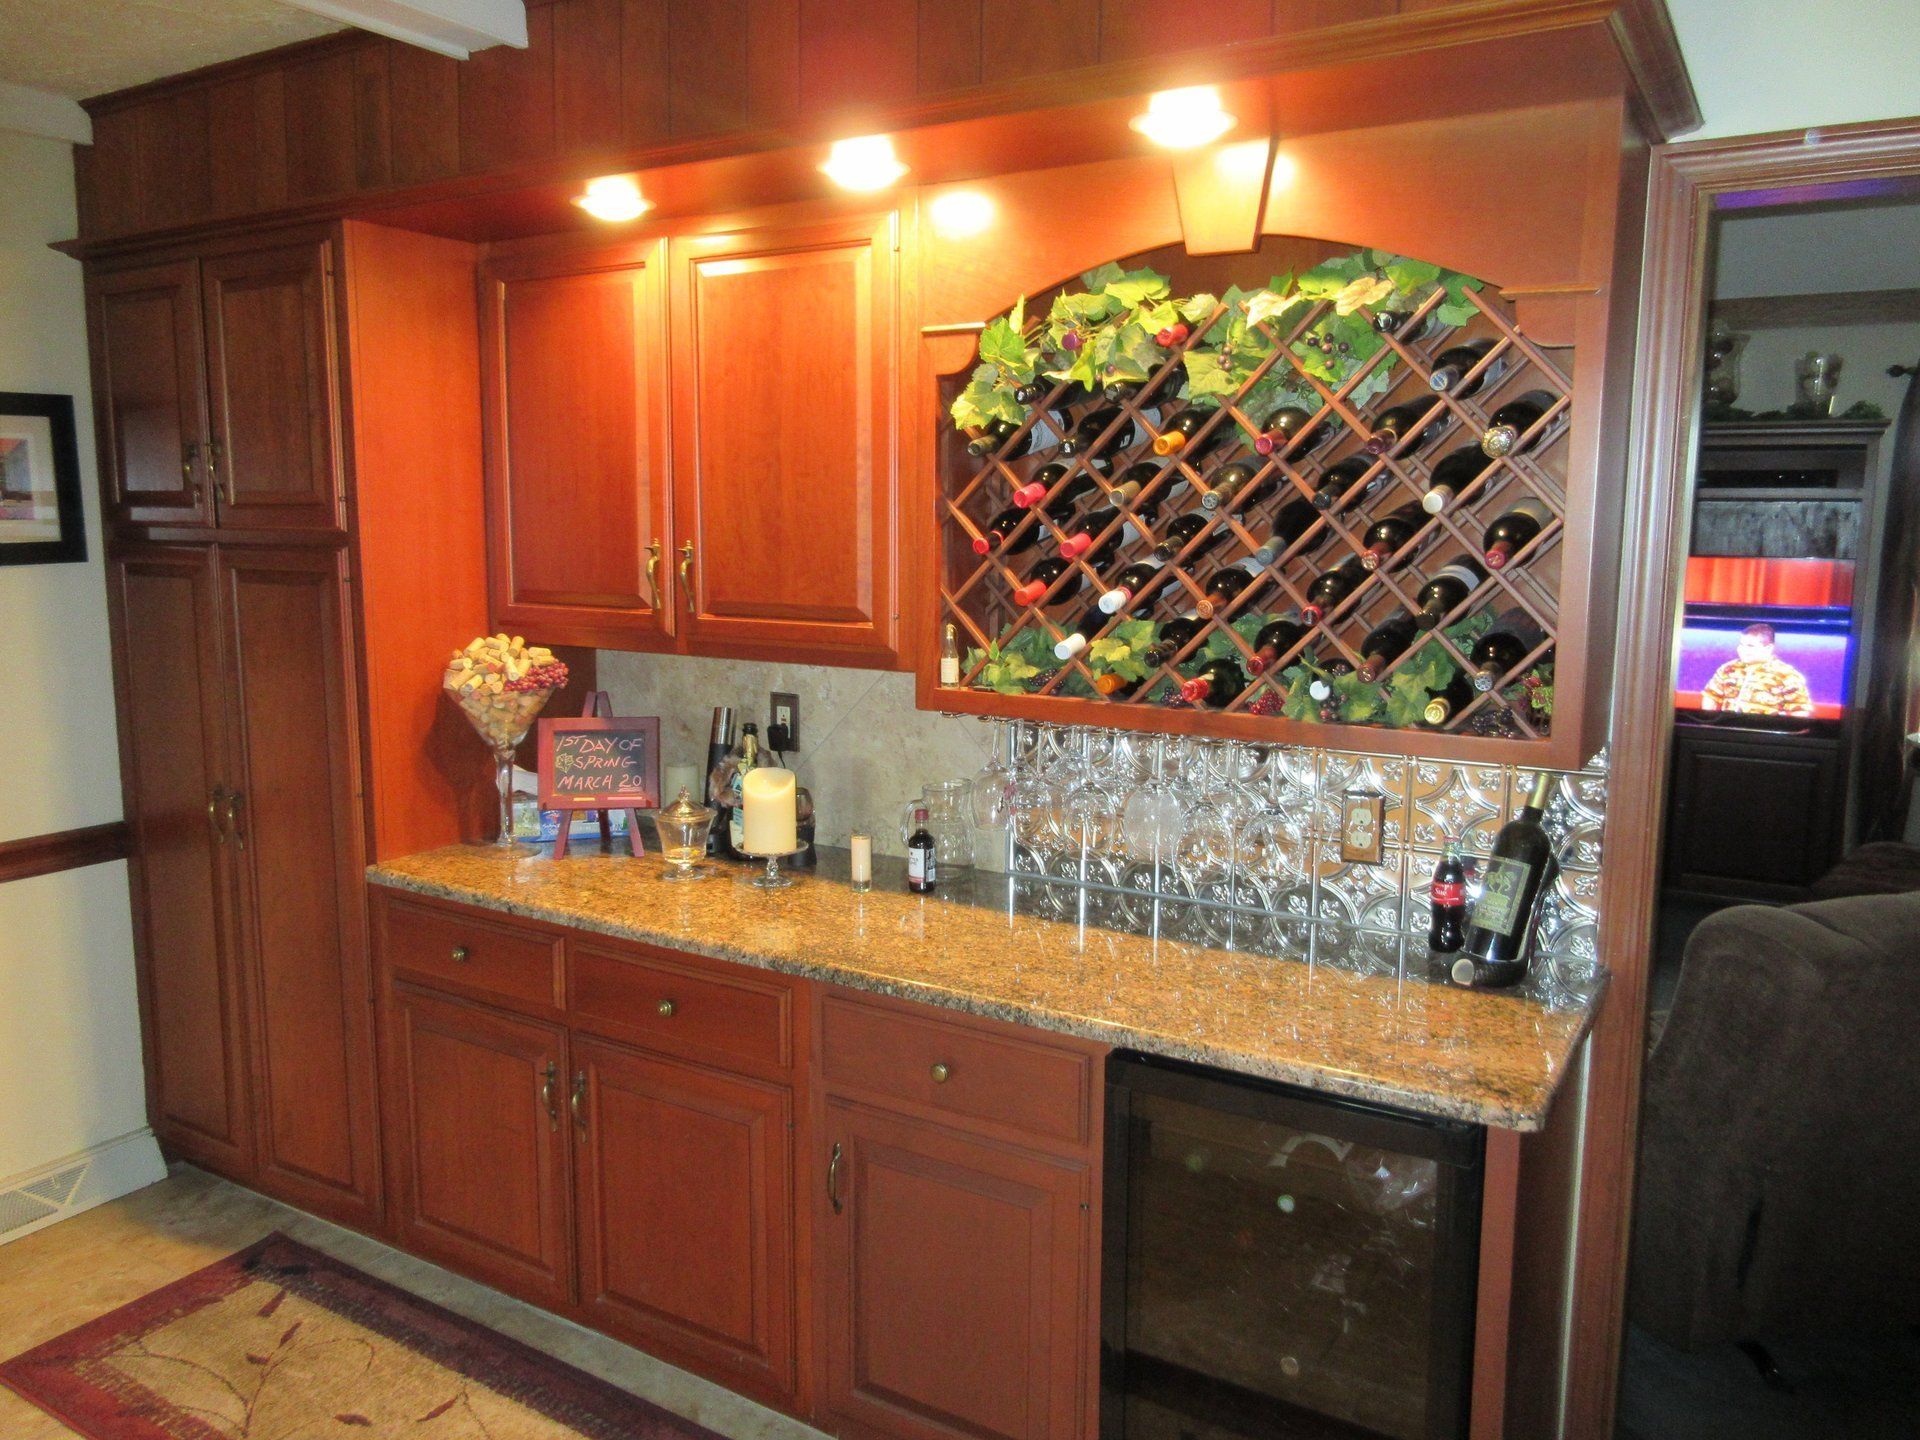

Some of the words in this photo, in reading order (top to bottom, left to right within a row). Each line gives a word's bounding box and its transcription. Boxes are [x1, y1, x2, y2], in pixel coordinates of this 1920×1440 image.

[580, 737, 618, 753] DAY
[619, 739, 642, 751] OF
[573, 756, 637, 770] SPRING
[557, 775, 613, 790] MARCH
[619, 774, 642, 787] 20
